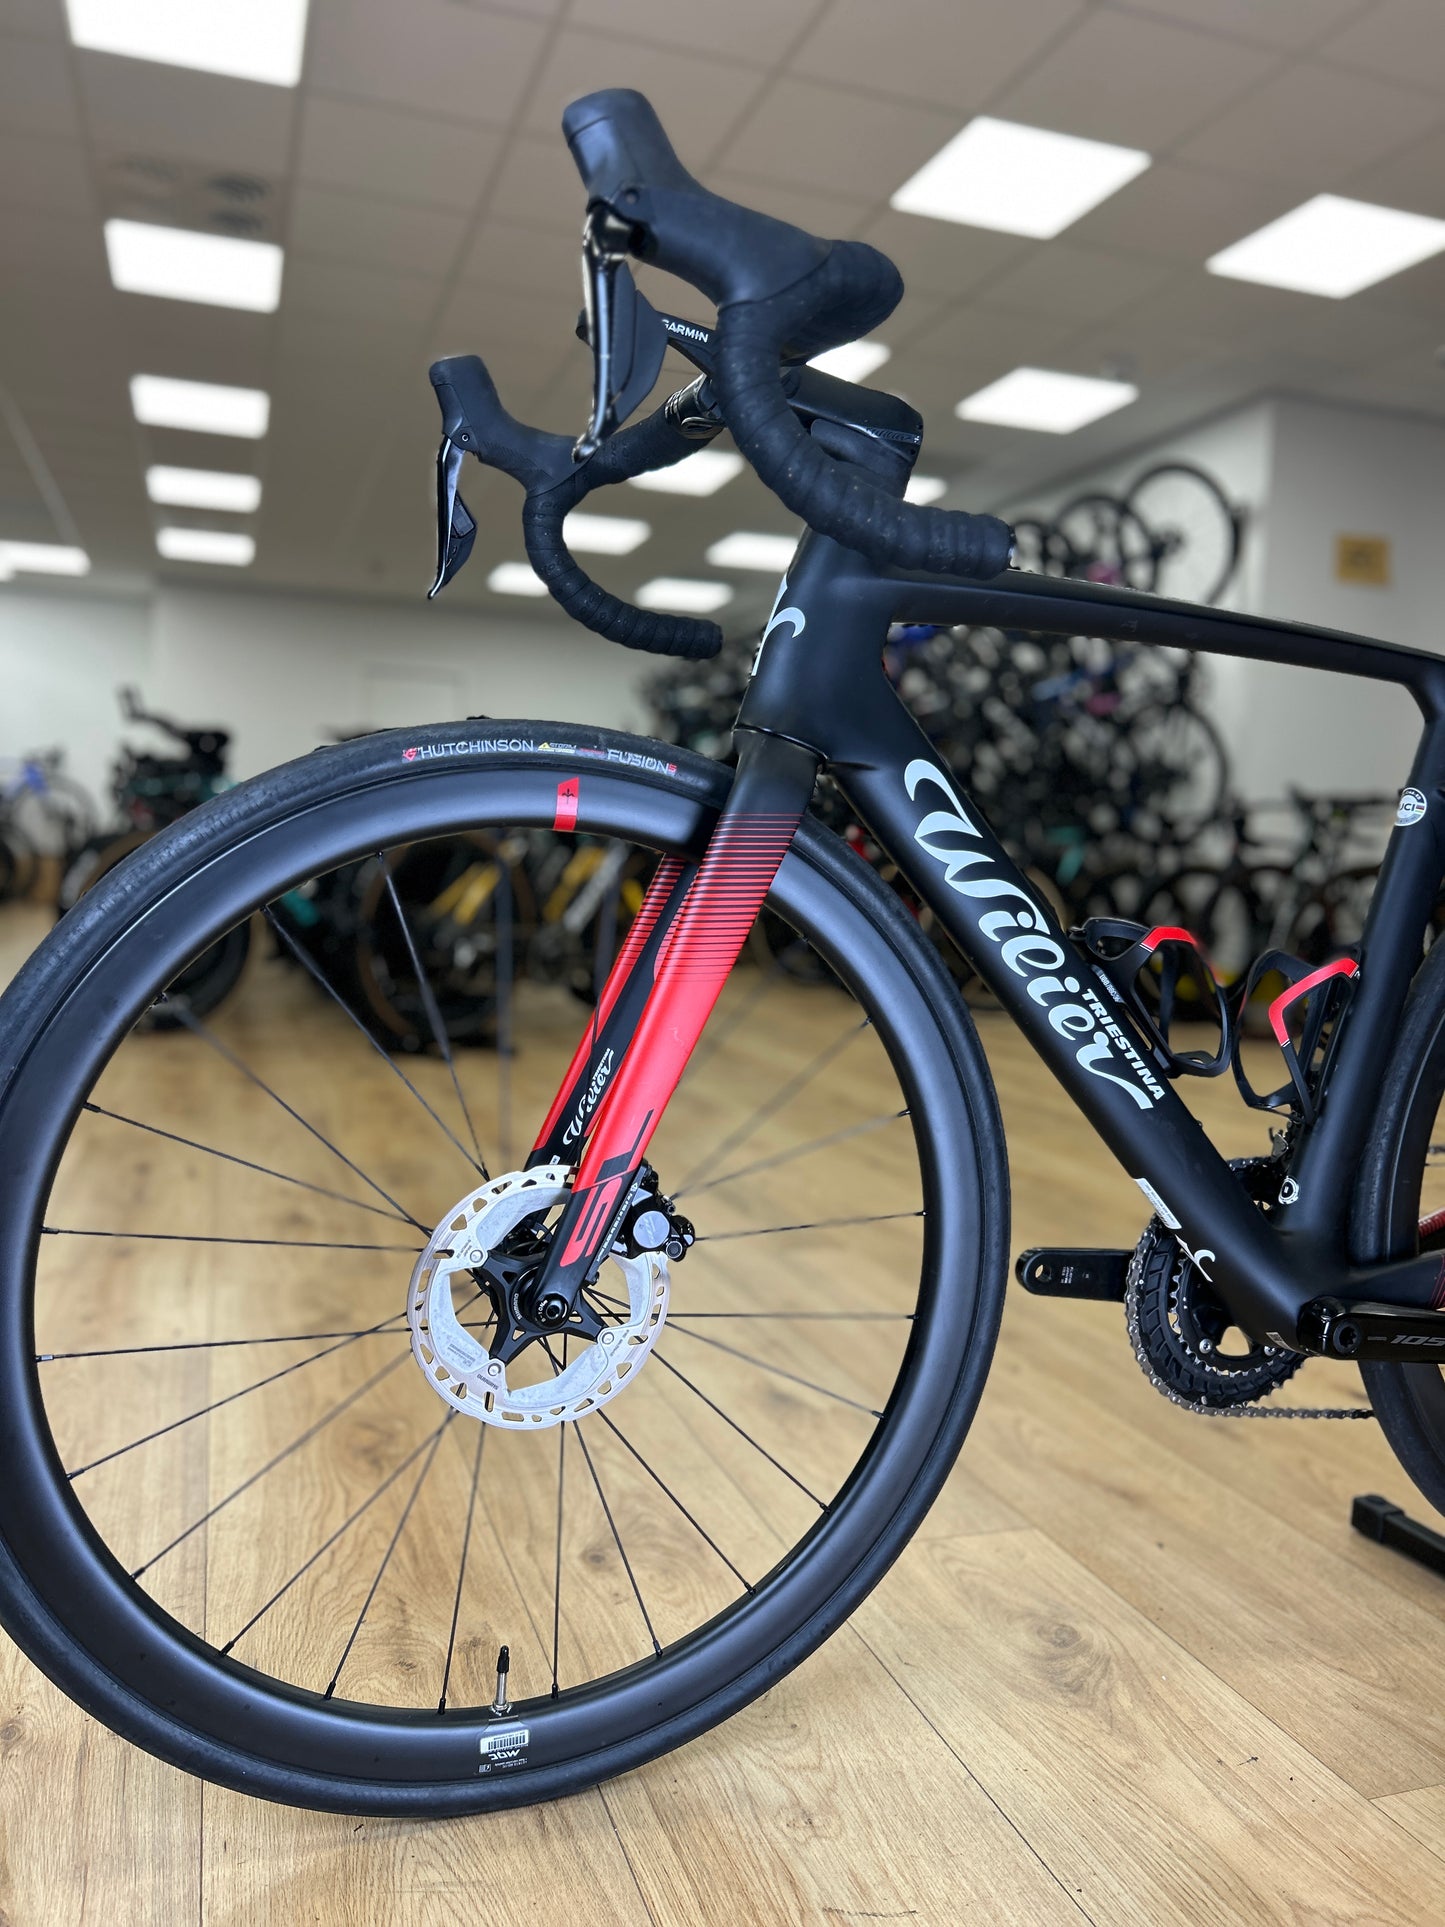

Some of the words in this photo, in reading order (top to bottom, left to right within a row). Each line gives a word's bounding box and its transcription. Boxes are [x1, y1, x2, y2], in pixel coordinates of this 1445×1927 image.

[662, 318, 709, 343] GARMIN
[419, 739, 534, 760] HUTCHINSON
[1081, 988, 1166, 1100] TRIESTINA
[1390, 1334, 1445, 1347] 105
